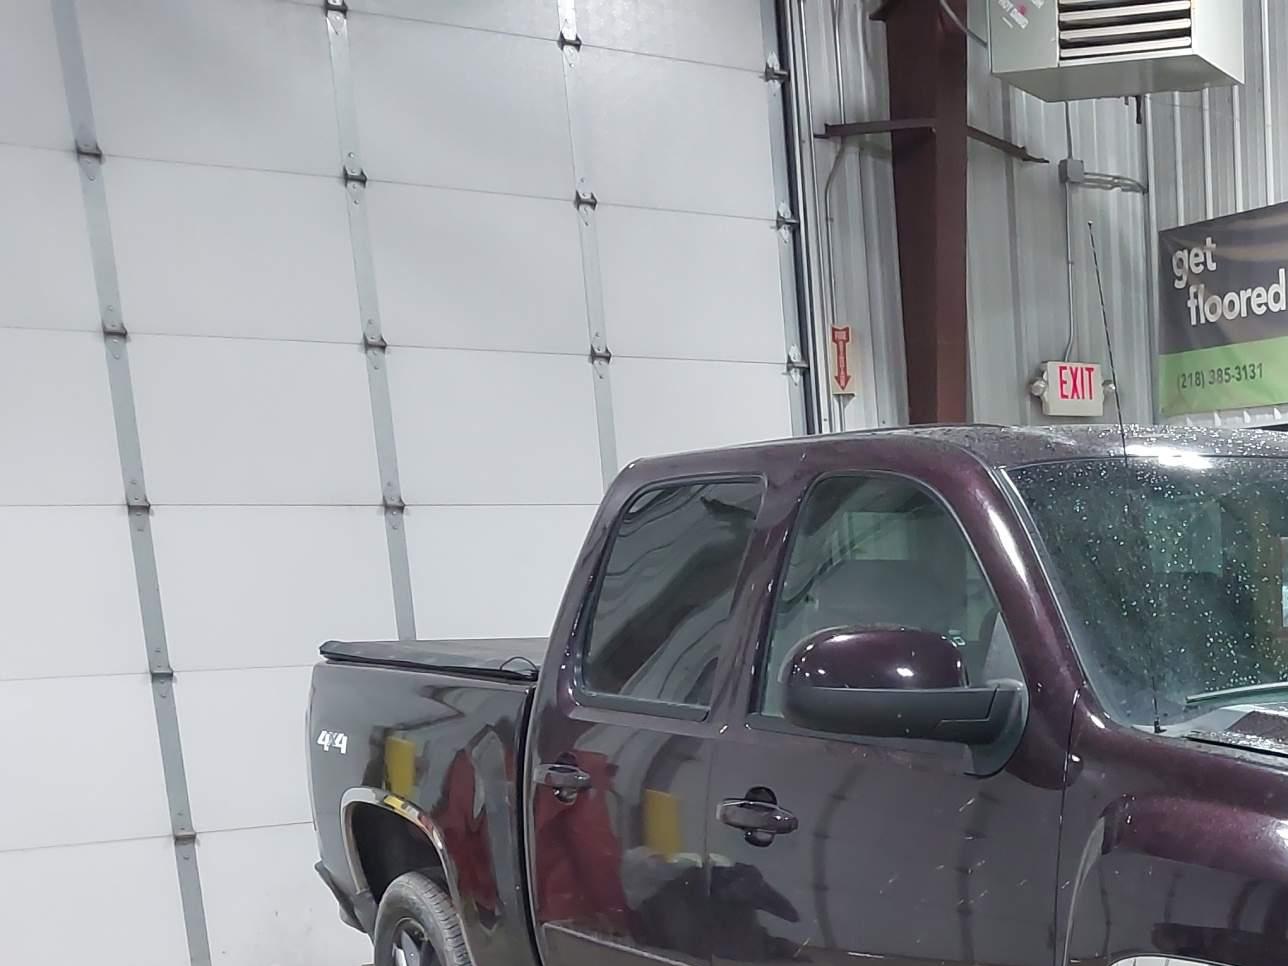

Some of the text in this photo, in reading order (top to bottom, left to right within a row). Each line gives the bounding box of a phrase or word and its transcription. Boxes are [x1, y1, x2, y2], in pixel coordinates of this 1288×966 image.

[1172, 237, 1217, 289] get
[1187, 268, 1287, 326] floored
[1059, 366, 1095, 400] EXIT
[1177, 363, 1264, 389] (218) 385-3131
